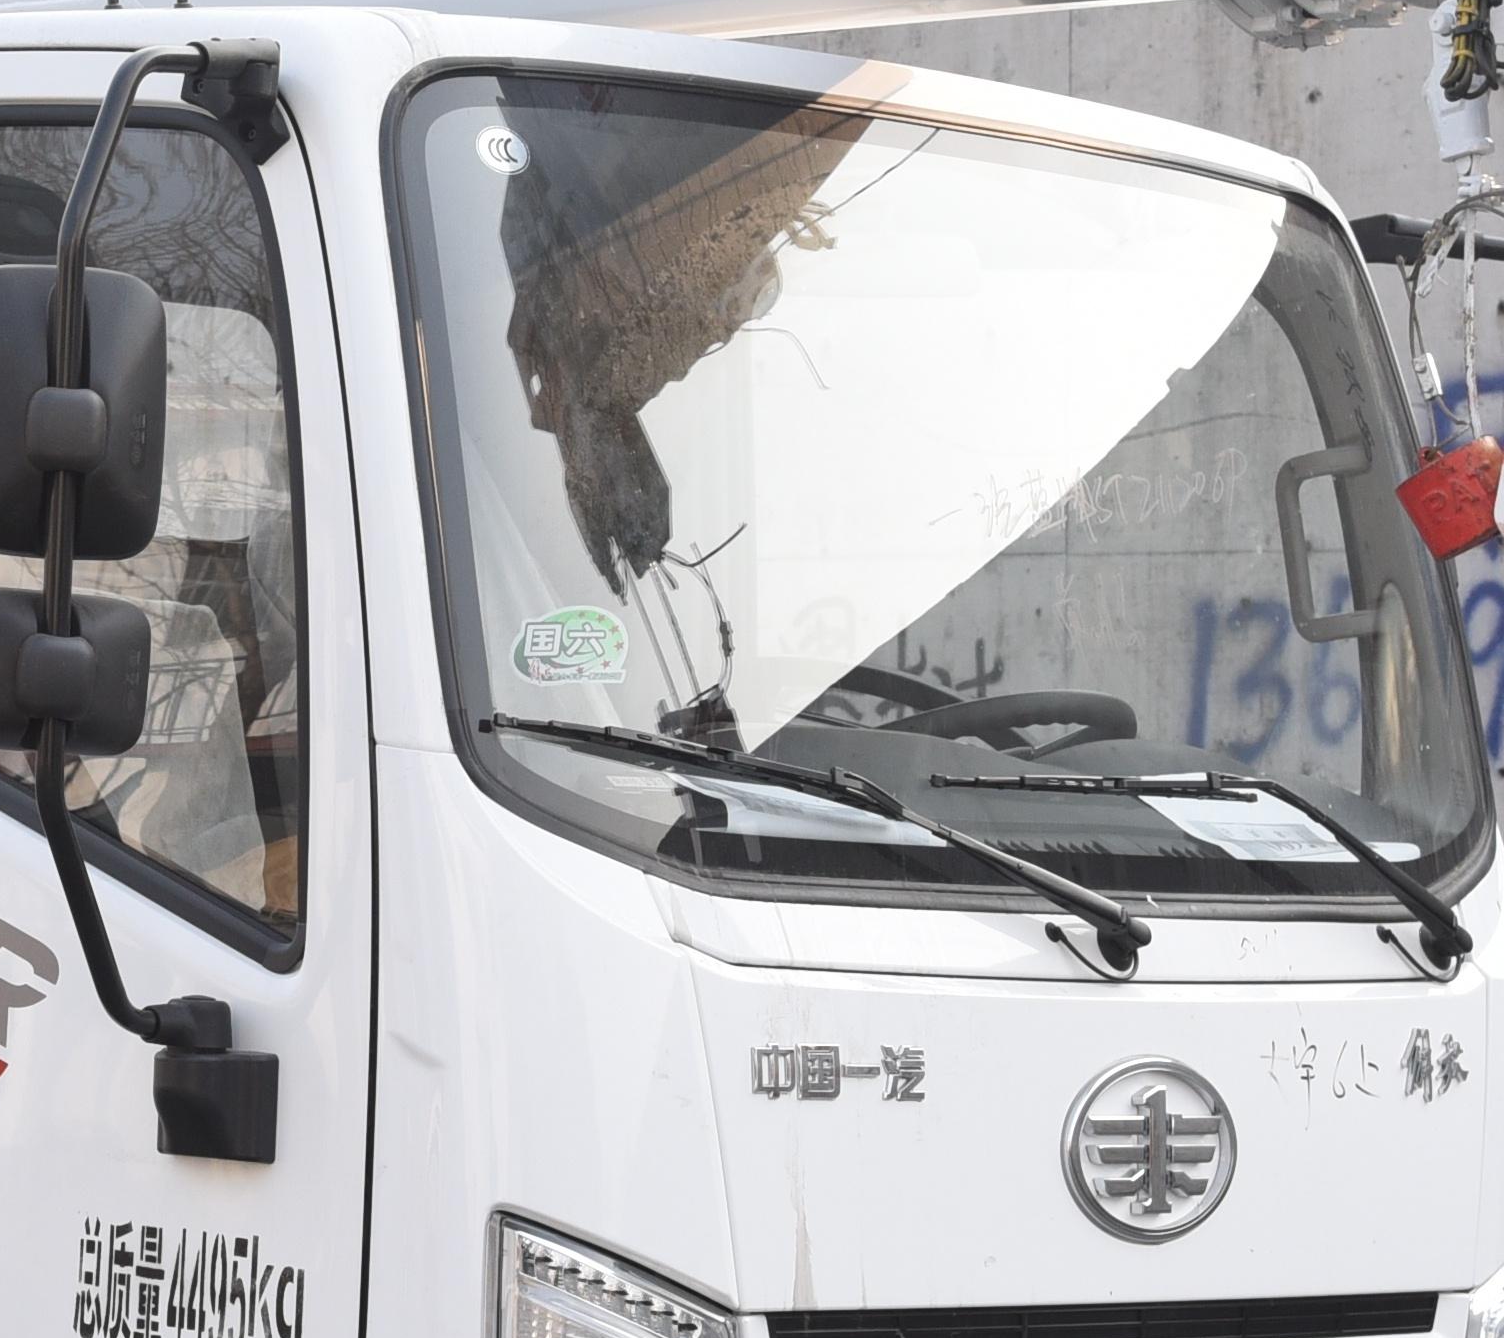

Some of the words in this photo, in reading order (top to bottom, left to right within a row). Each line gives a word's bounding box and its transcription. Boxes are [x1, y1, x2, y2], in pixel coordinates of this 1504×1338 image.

[523, 621, 608, 659] 国六
[749, 1042, 927, 1103] 中国一汽
